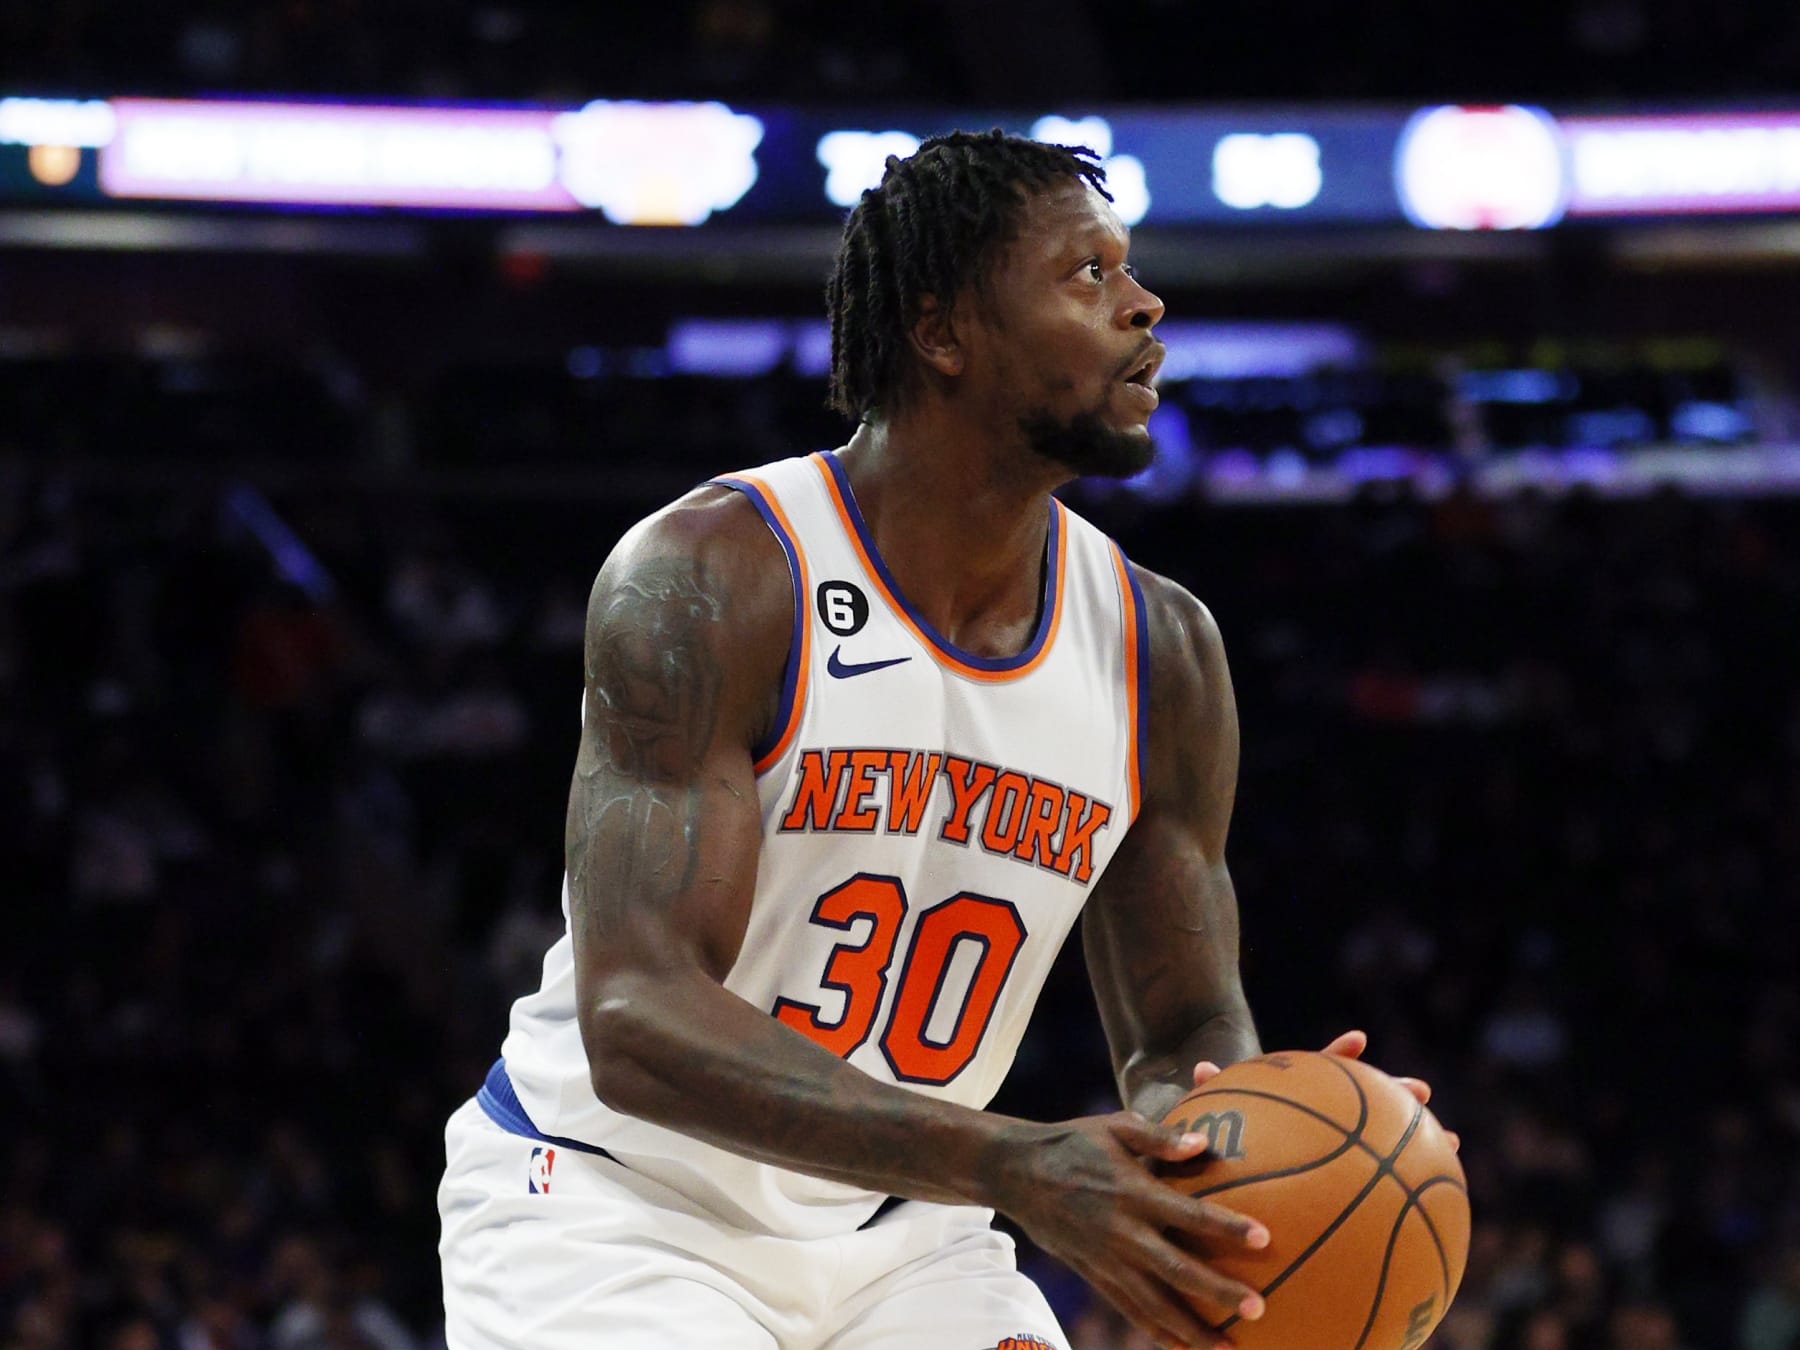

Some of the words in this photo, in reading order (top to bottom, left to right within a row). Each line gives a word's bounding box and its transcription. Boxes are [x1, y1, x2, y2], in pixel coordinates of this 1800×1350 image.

[825, 588, 855, 631] 6
[778, 747, 940, 835] NEW
[935, 752, 1114, 887] YORK
[773, 872, 1028, 1086] 30
